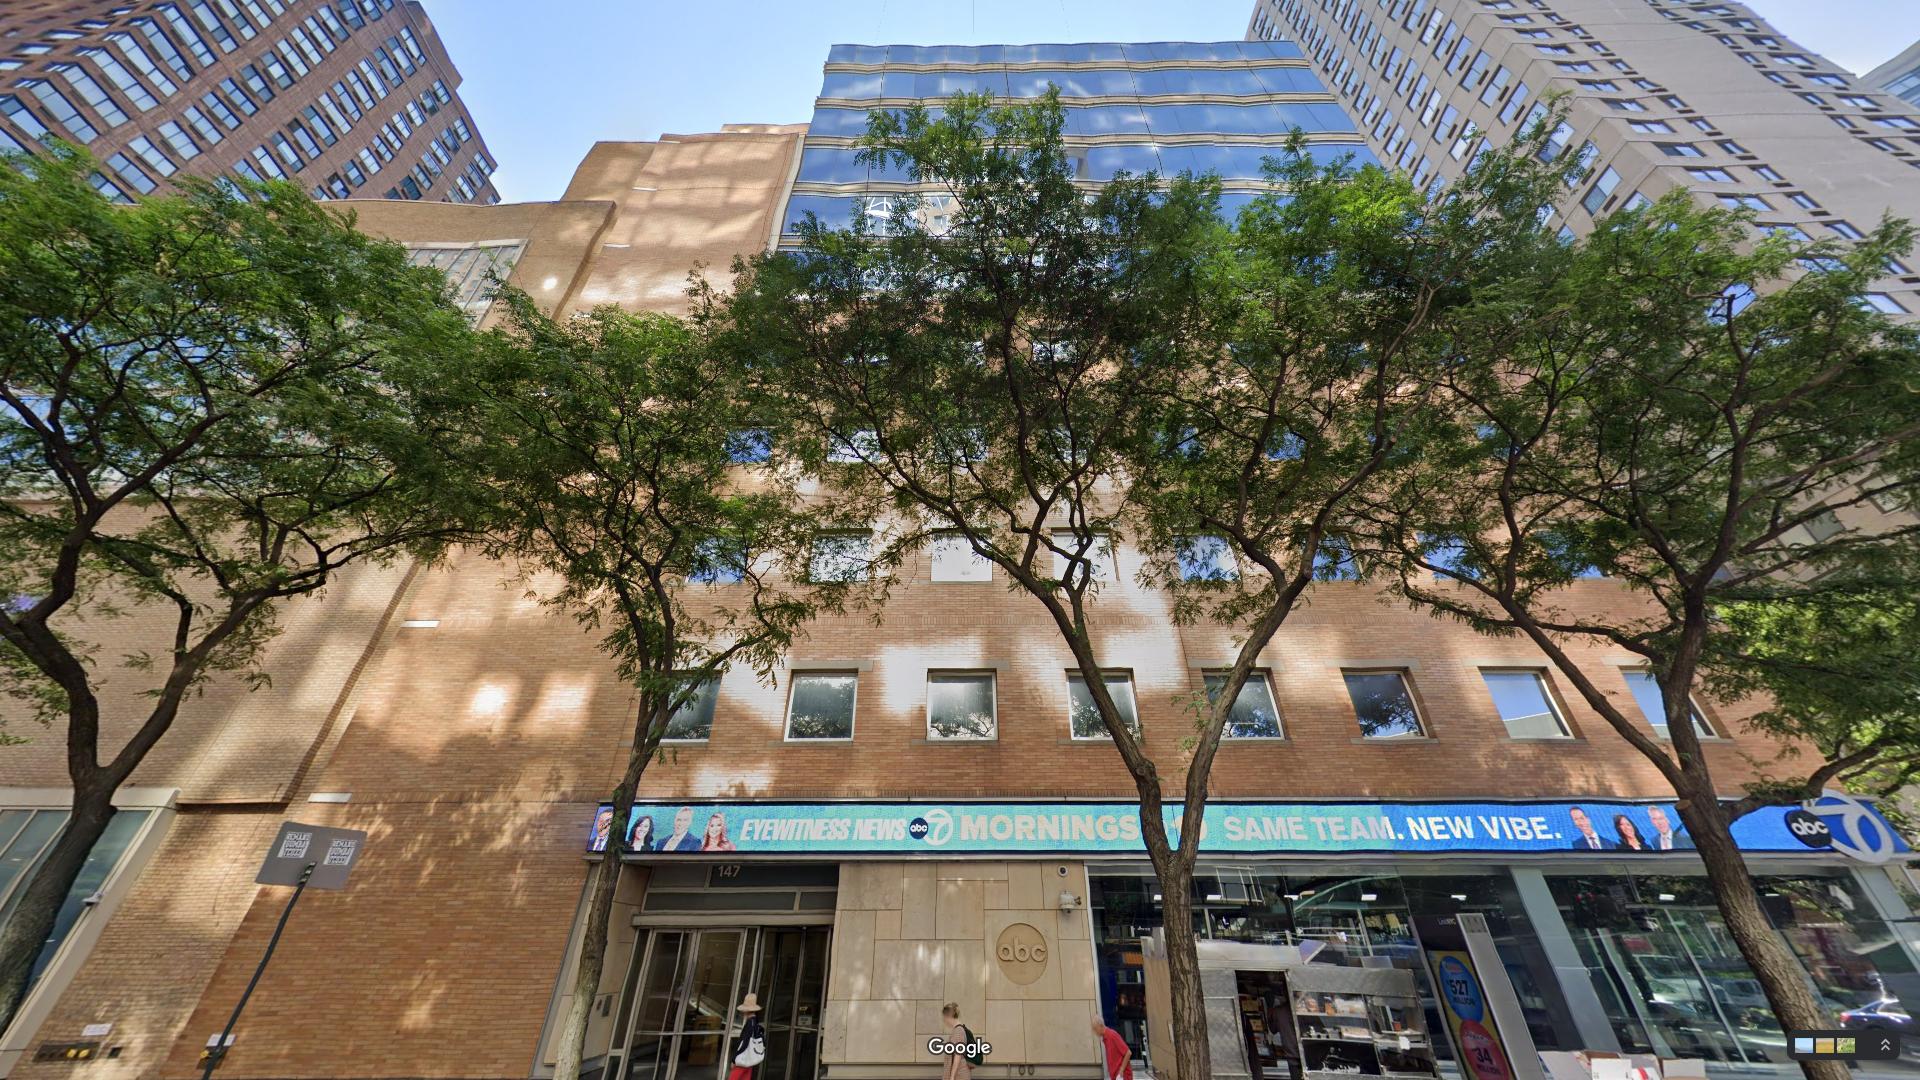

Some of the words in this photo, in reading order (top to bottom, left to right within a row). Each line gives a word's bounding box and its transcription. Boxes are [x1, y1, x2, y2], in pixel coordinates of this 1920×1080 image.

[739, 819, 851, 841] EYEWITNESS
[852, 819, 906, 841] NEWS
[910, 823, 928, 833] abc
[960, 814, 1140, 841] MORNINGS
[1223, 816, 1309, 841] SAME
[1310, 816, 1404, 841] TEAM.
[1406, 816, 1475, 841] NEW
[1477, 816, 1562, 841] VIBE.
[1791, 818, 1829, 835] abc
[718, 865, 741, 877] 147
[997, 936, 1047, 963] abc
